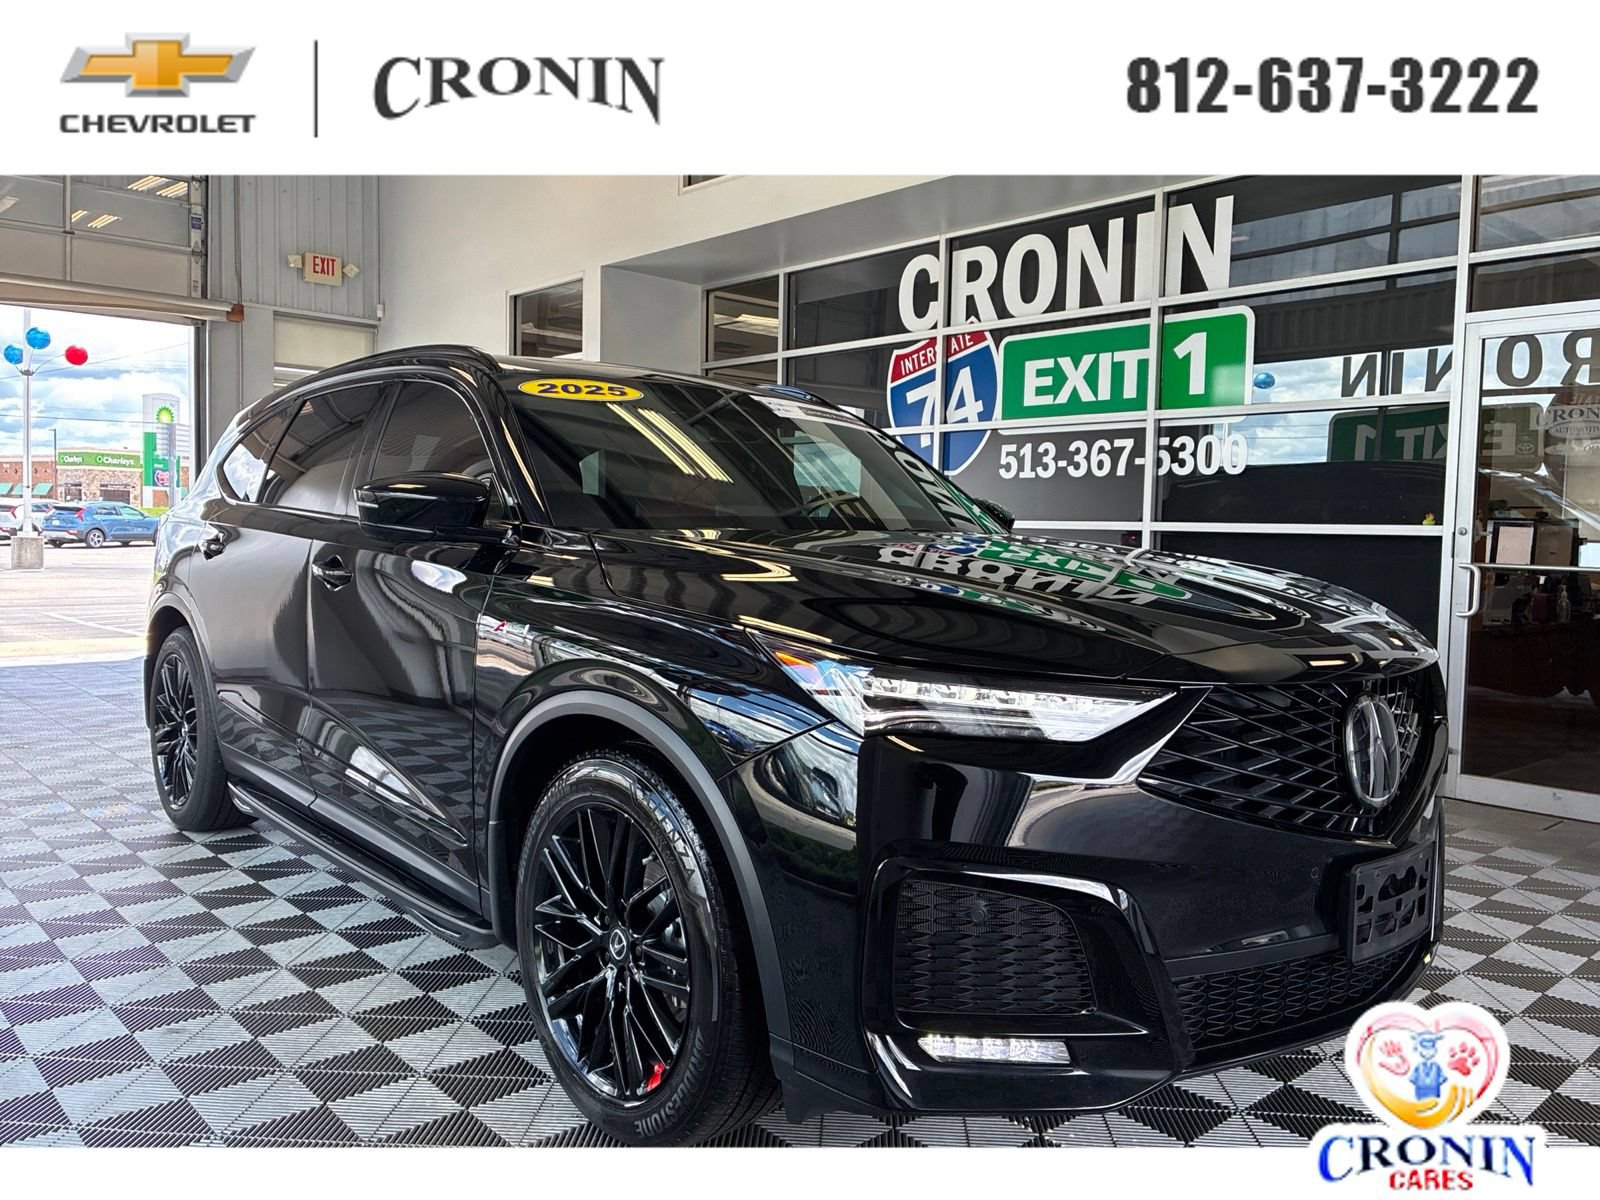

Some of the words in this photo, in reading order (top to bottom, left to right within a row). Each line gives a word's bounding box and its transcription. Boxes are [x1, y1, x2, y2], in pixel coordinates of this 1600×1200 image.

[313, 256, 336, 276] EXIT
[899, 195, 1234, 332] CRONIN
[901, 333, 974, 375] INTERATE
[1023, 349, 1150, 407] EXIT
[1173, 332, 1207, 395] 1
[537, 383, 628, 396] 2025
[906, 366, 984, 448] 74
[999, 433, 1248, 480] 513-367-5300
